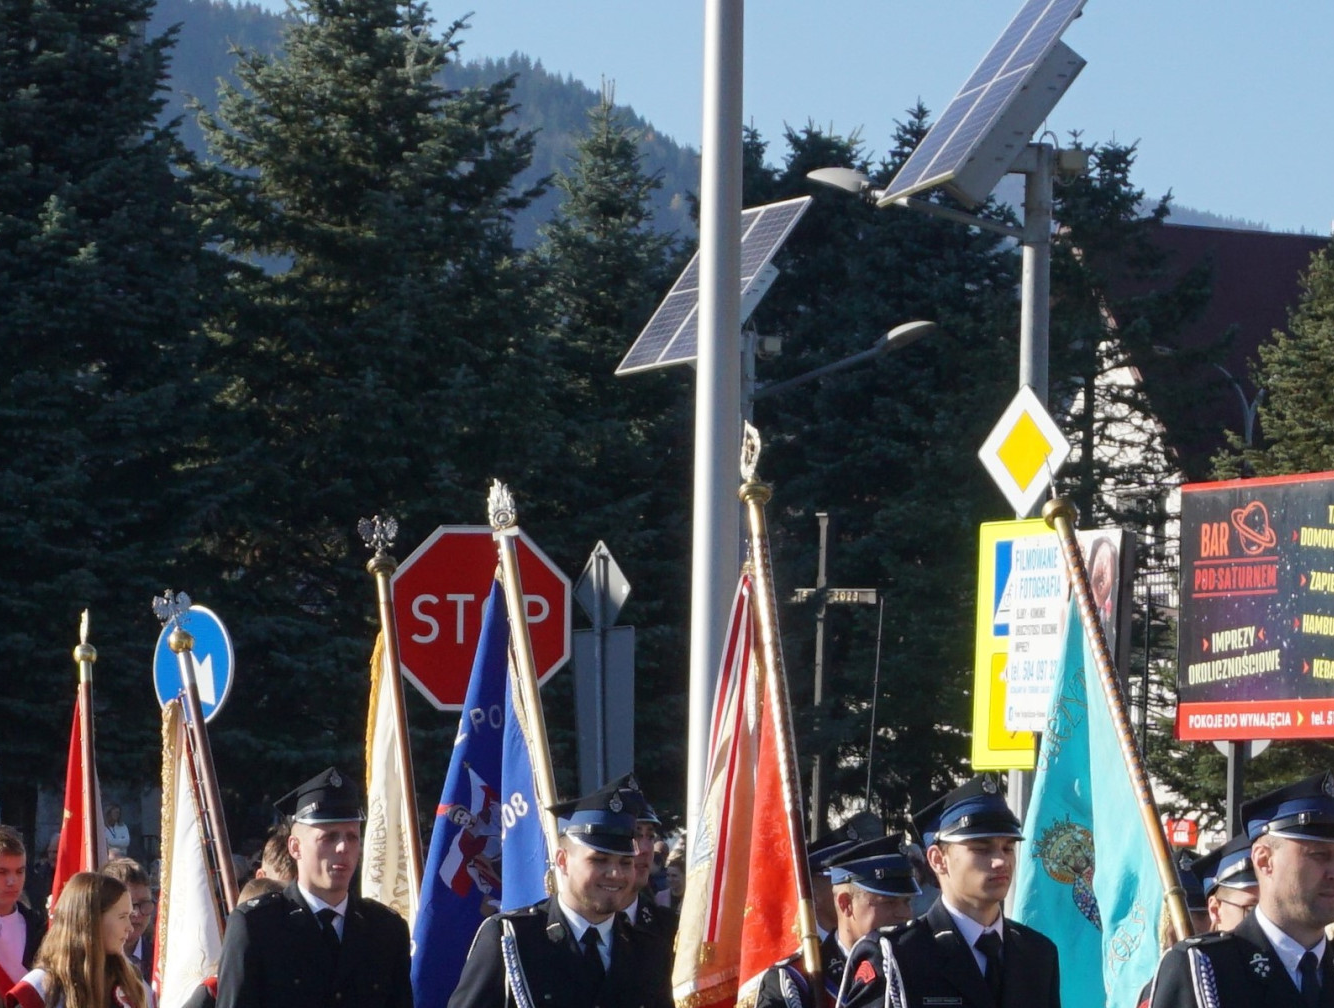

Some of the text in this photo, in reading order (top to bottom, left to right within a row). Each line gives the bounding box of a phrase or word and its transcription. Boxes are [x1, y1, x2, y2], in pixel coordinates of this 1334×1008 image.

[1201, 522, 1229, 557] BAR
[1015, 547, 1058, 571] FILMOWANIE
[1020, 575, 1061, 600] FOTOGRAFIA
[1194, 564, 1278, 591] POD SATURNEM
[1212, 626, 1256, 653] IMPREZY
[1188, 650, 1280, 685] OKOLICZNOŚCIOWE
[1189, 713, 1223, 729] POKOJE
[1224, 714, 1238, 728] DO
[1239, 711, 1292, 731] WYNAJĘCIA
[1311, 712, 1325, 725] tel.
